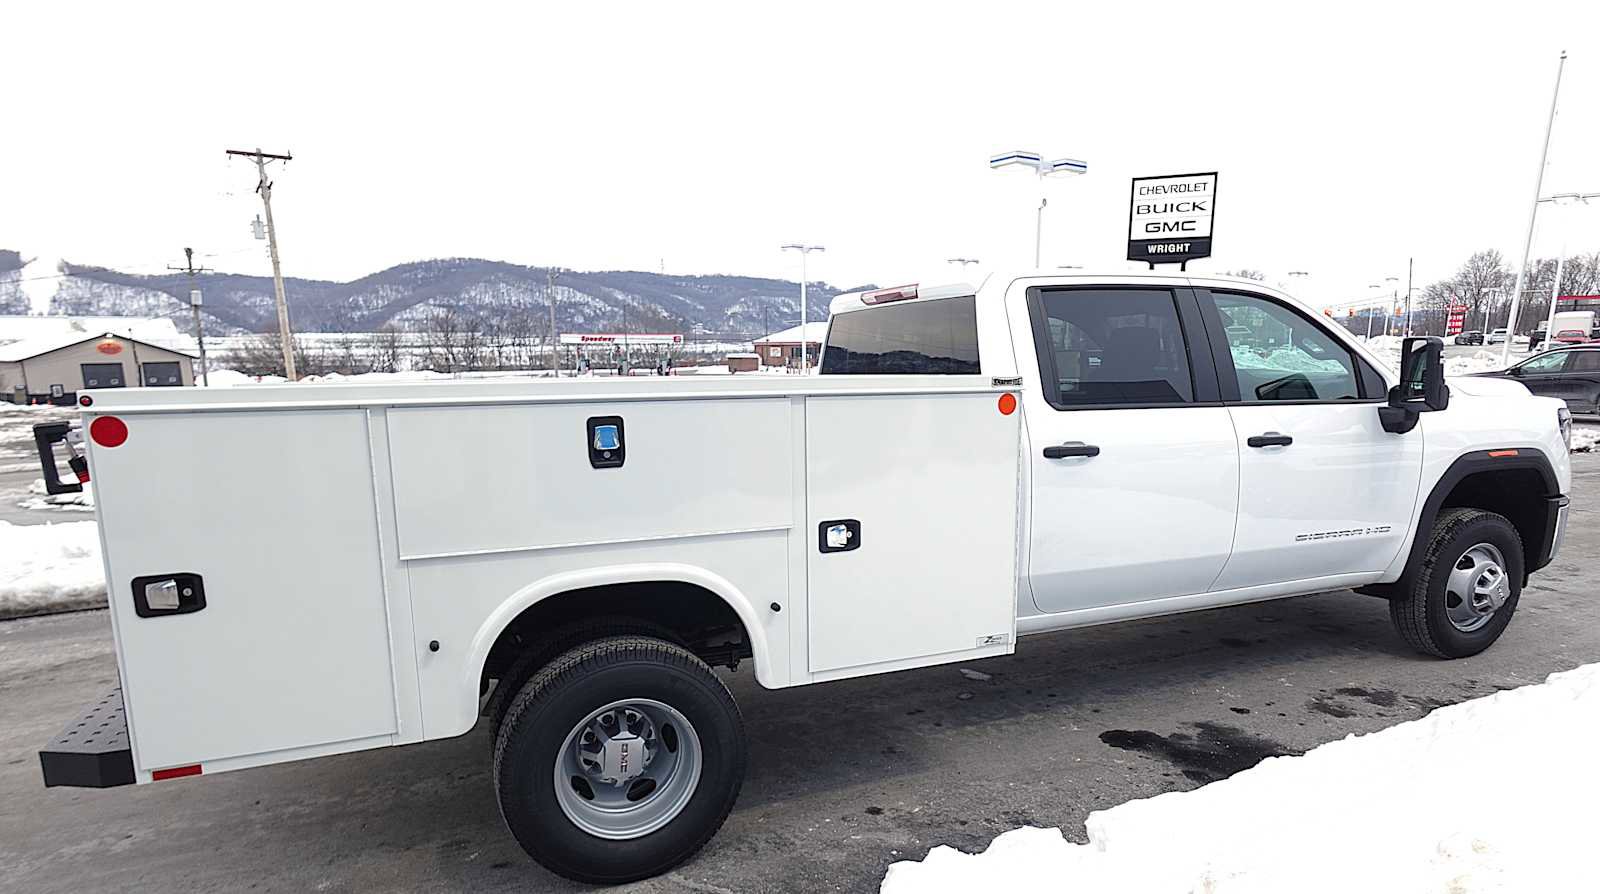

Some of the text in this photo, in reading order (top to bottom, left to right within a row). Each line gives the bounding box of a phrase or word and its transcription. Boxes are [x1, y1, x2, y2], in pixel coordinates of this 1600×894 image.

[1139, 182, 1208, 196] CHEVROLET
[1136, 201, 1207, 215] BUICK
[1145, 220, 1197, 233] GMC
[1147, 243, 1191, 254] WRIGHT
[581, 335, 616, 344] Speedway
[620, 743, 629, 773] GMC
